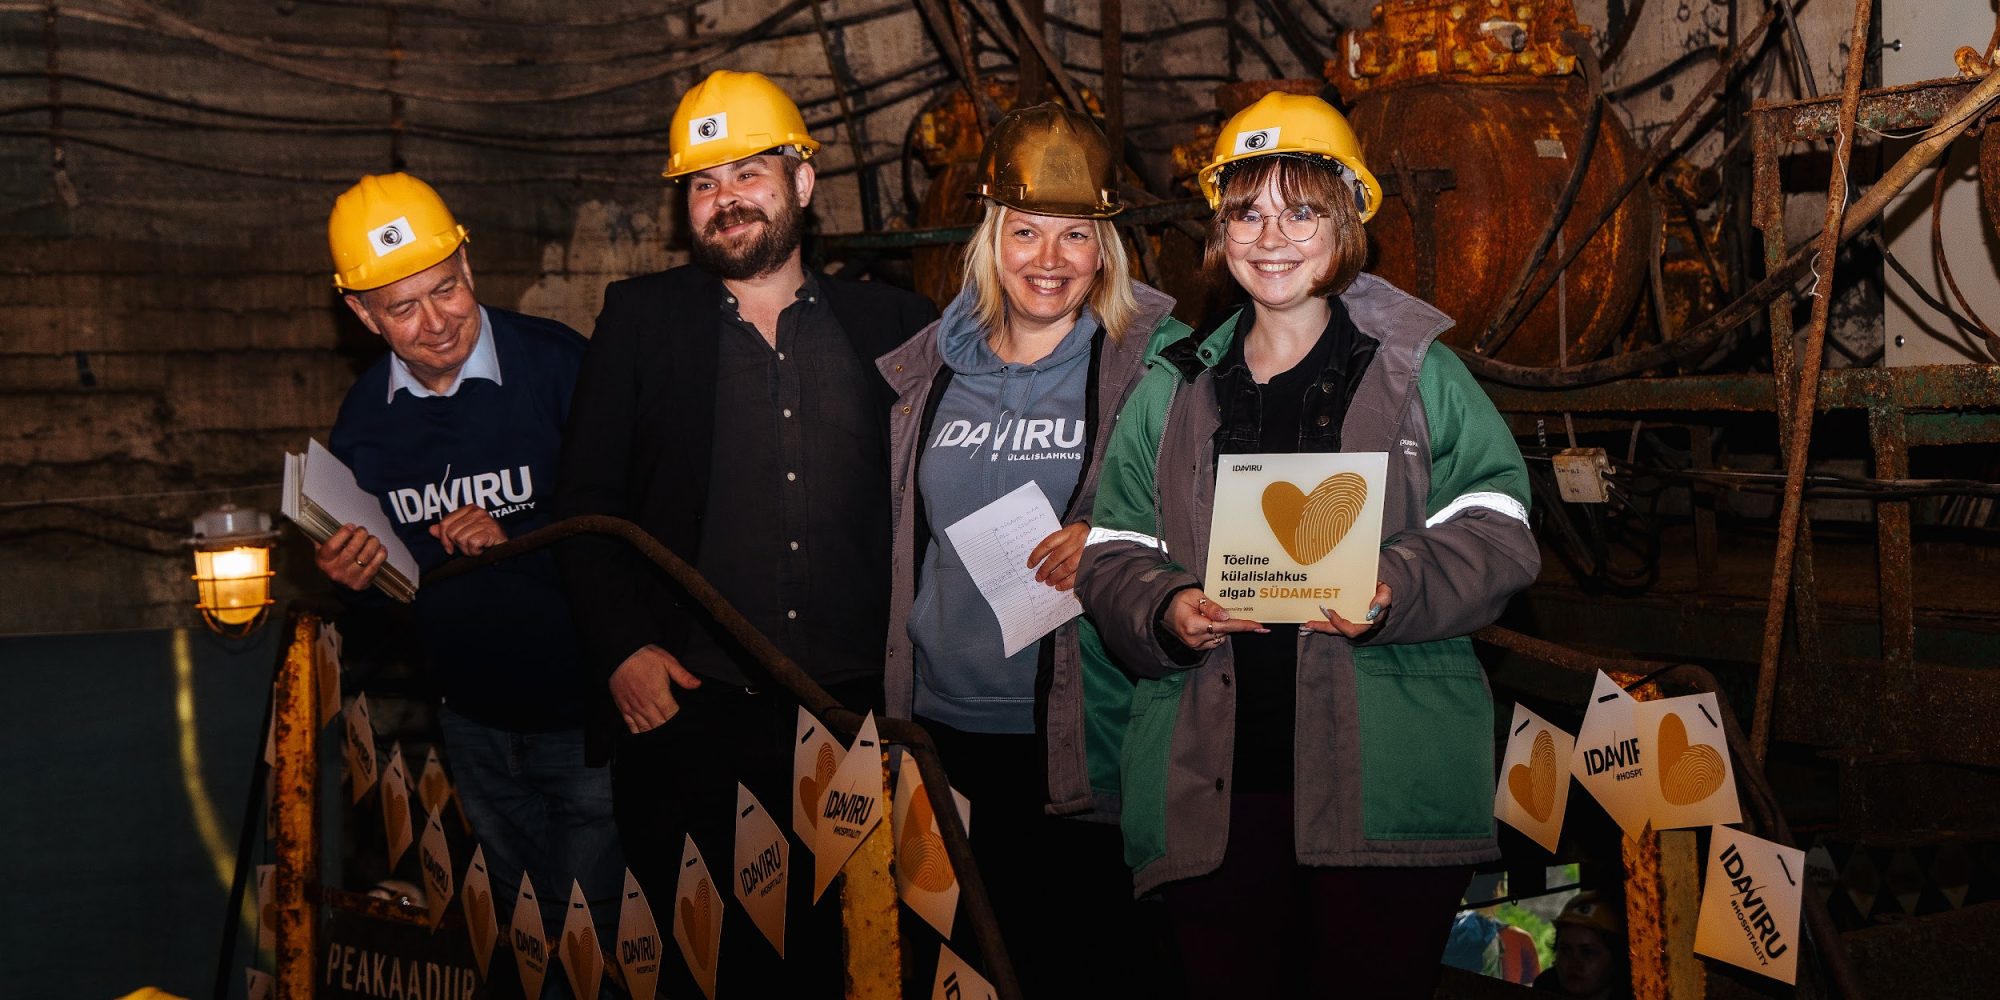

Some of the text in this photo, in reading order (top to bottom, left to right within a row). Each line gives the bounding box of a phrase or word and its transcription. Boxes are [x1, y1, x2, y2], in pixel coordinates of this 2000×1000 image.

[931, 414, 1085, 454] IDAVIRU
[991, 452, 1082, 462] #ÜLALISLAHKUS
[1232, 463, 1263, 473] IDAVIRU
[387, 464, 533, 524] IDAVIRU
[488, 502, 536, 519] ITALITY
[1223, 554, 1270, 566] Tõeline
[1221, 570, 1308, 582] külalislahkus
[1219, 586, 1342, 600] algab SÜDAMEST
[1583, 736, 1641, 776] IDAVIR
[1615, 767, 1643, 782] #HOSPI
[823, 789, 875, 827] IDAVIRU
[740, 840, 782, 896] IDAVIRU
[1719, 843, 1788, 960] IDAVIRU
[1729, 899, 1769, 967] #HOSPITALITY
[621, 935, 656, 964] IDAVIRU
